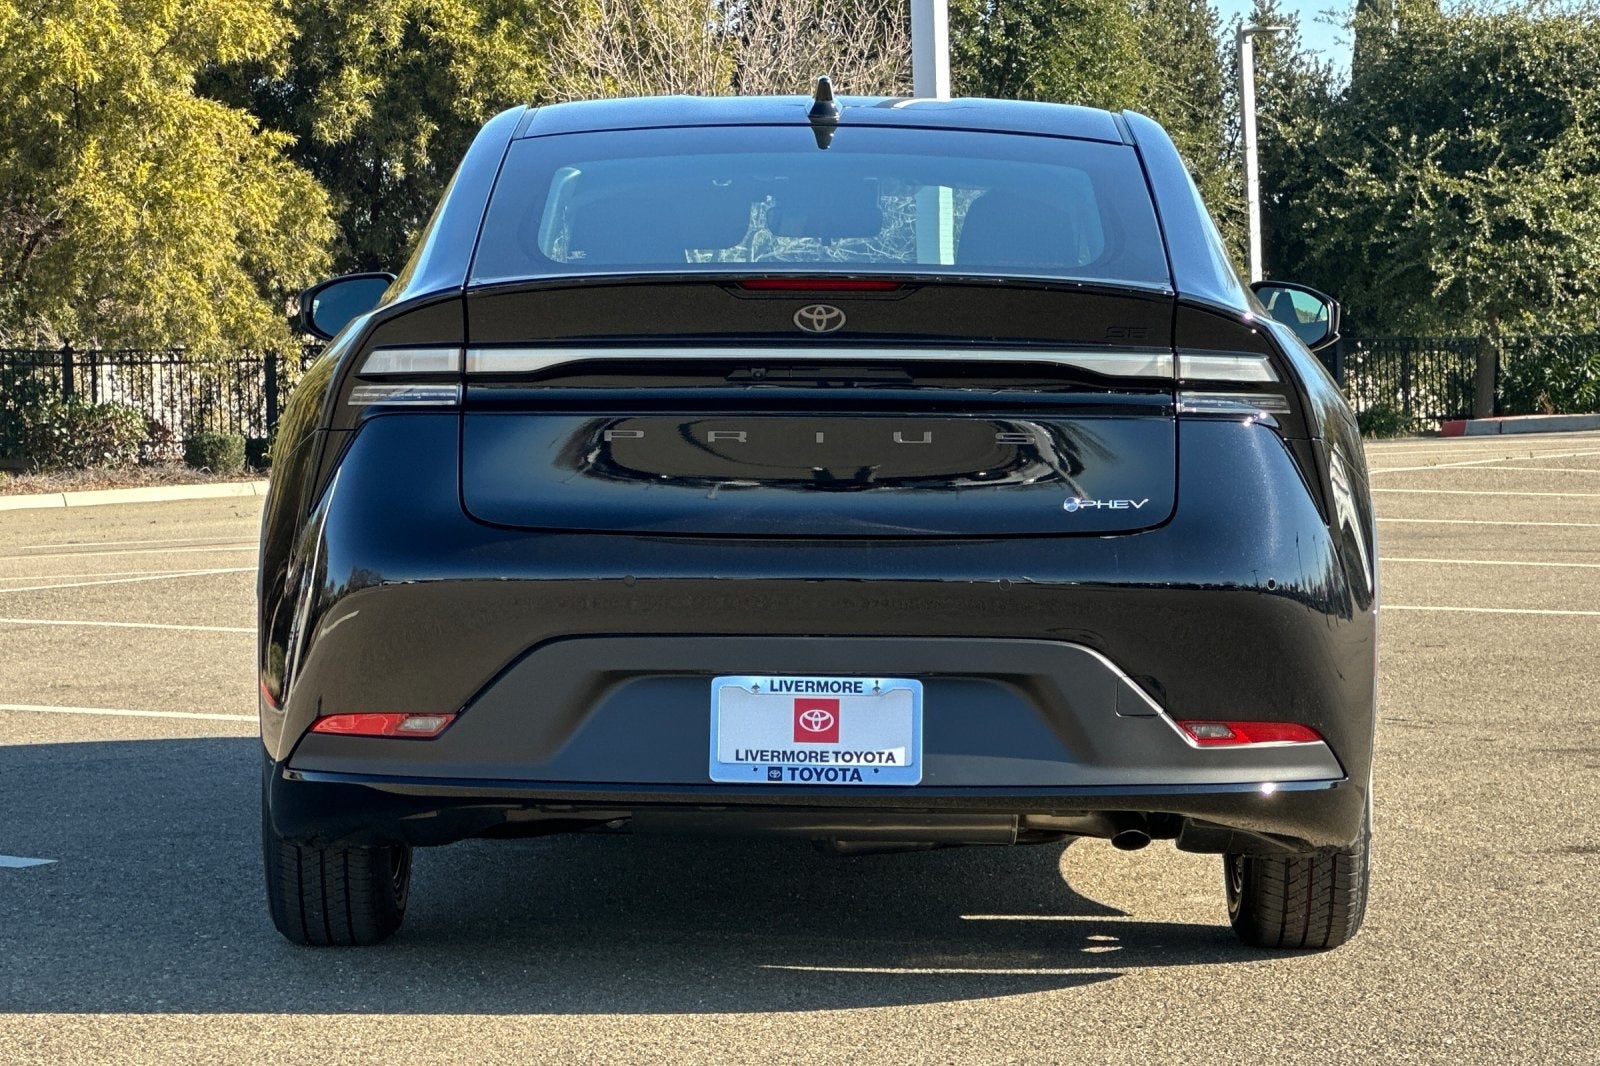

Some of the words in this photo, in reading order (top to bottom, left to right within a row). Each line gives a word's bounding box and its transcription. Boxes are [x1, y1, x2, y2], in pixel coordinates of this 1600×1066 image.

[1105, 326, 1149, 338] SE
[604, 429, 1035, 445] PRIUS
[1079, 498, 1149, 509] PHEV
[769, 680, 863, 693] LIVERMORE
[735, 749, 829, 763] LIVERMORE
[832, 750, 896, 763] TOYOTA
[787, 767, 863, 782] TOYOTA
